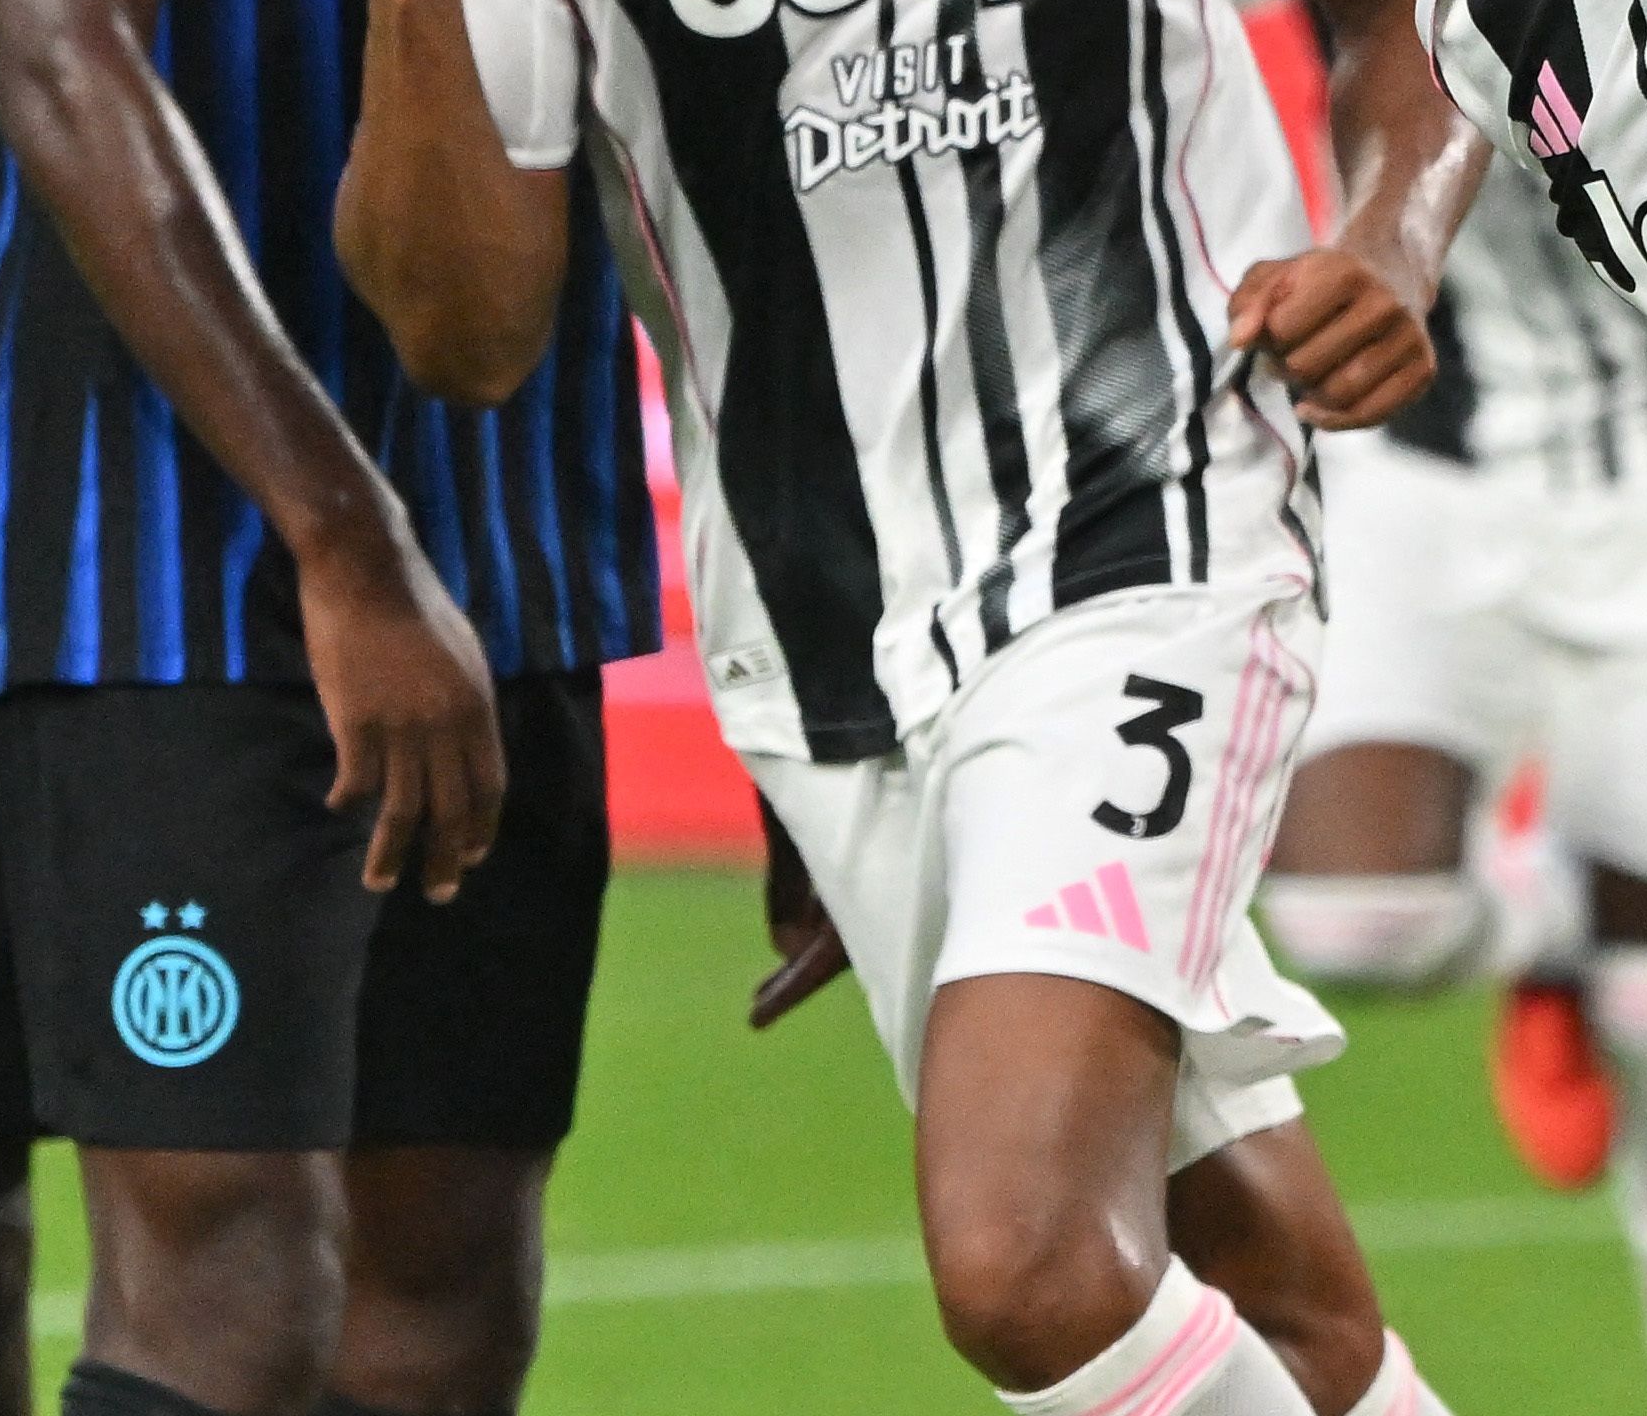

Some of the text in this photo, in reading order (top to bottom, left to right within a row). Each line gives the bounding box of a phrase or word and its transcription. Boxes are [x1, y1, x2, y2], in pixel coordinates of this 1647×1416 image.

[831, 33, 970, 107] VISIT
[782, 72, 1042, 192] Detroit
[1090, 673, 1206, 841] 3
